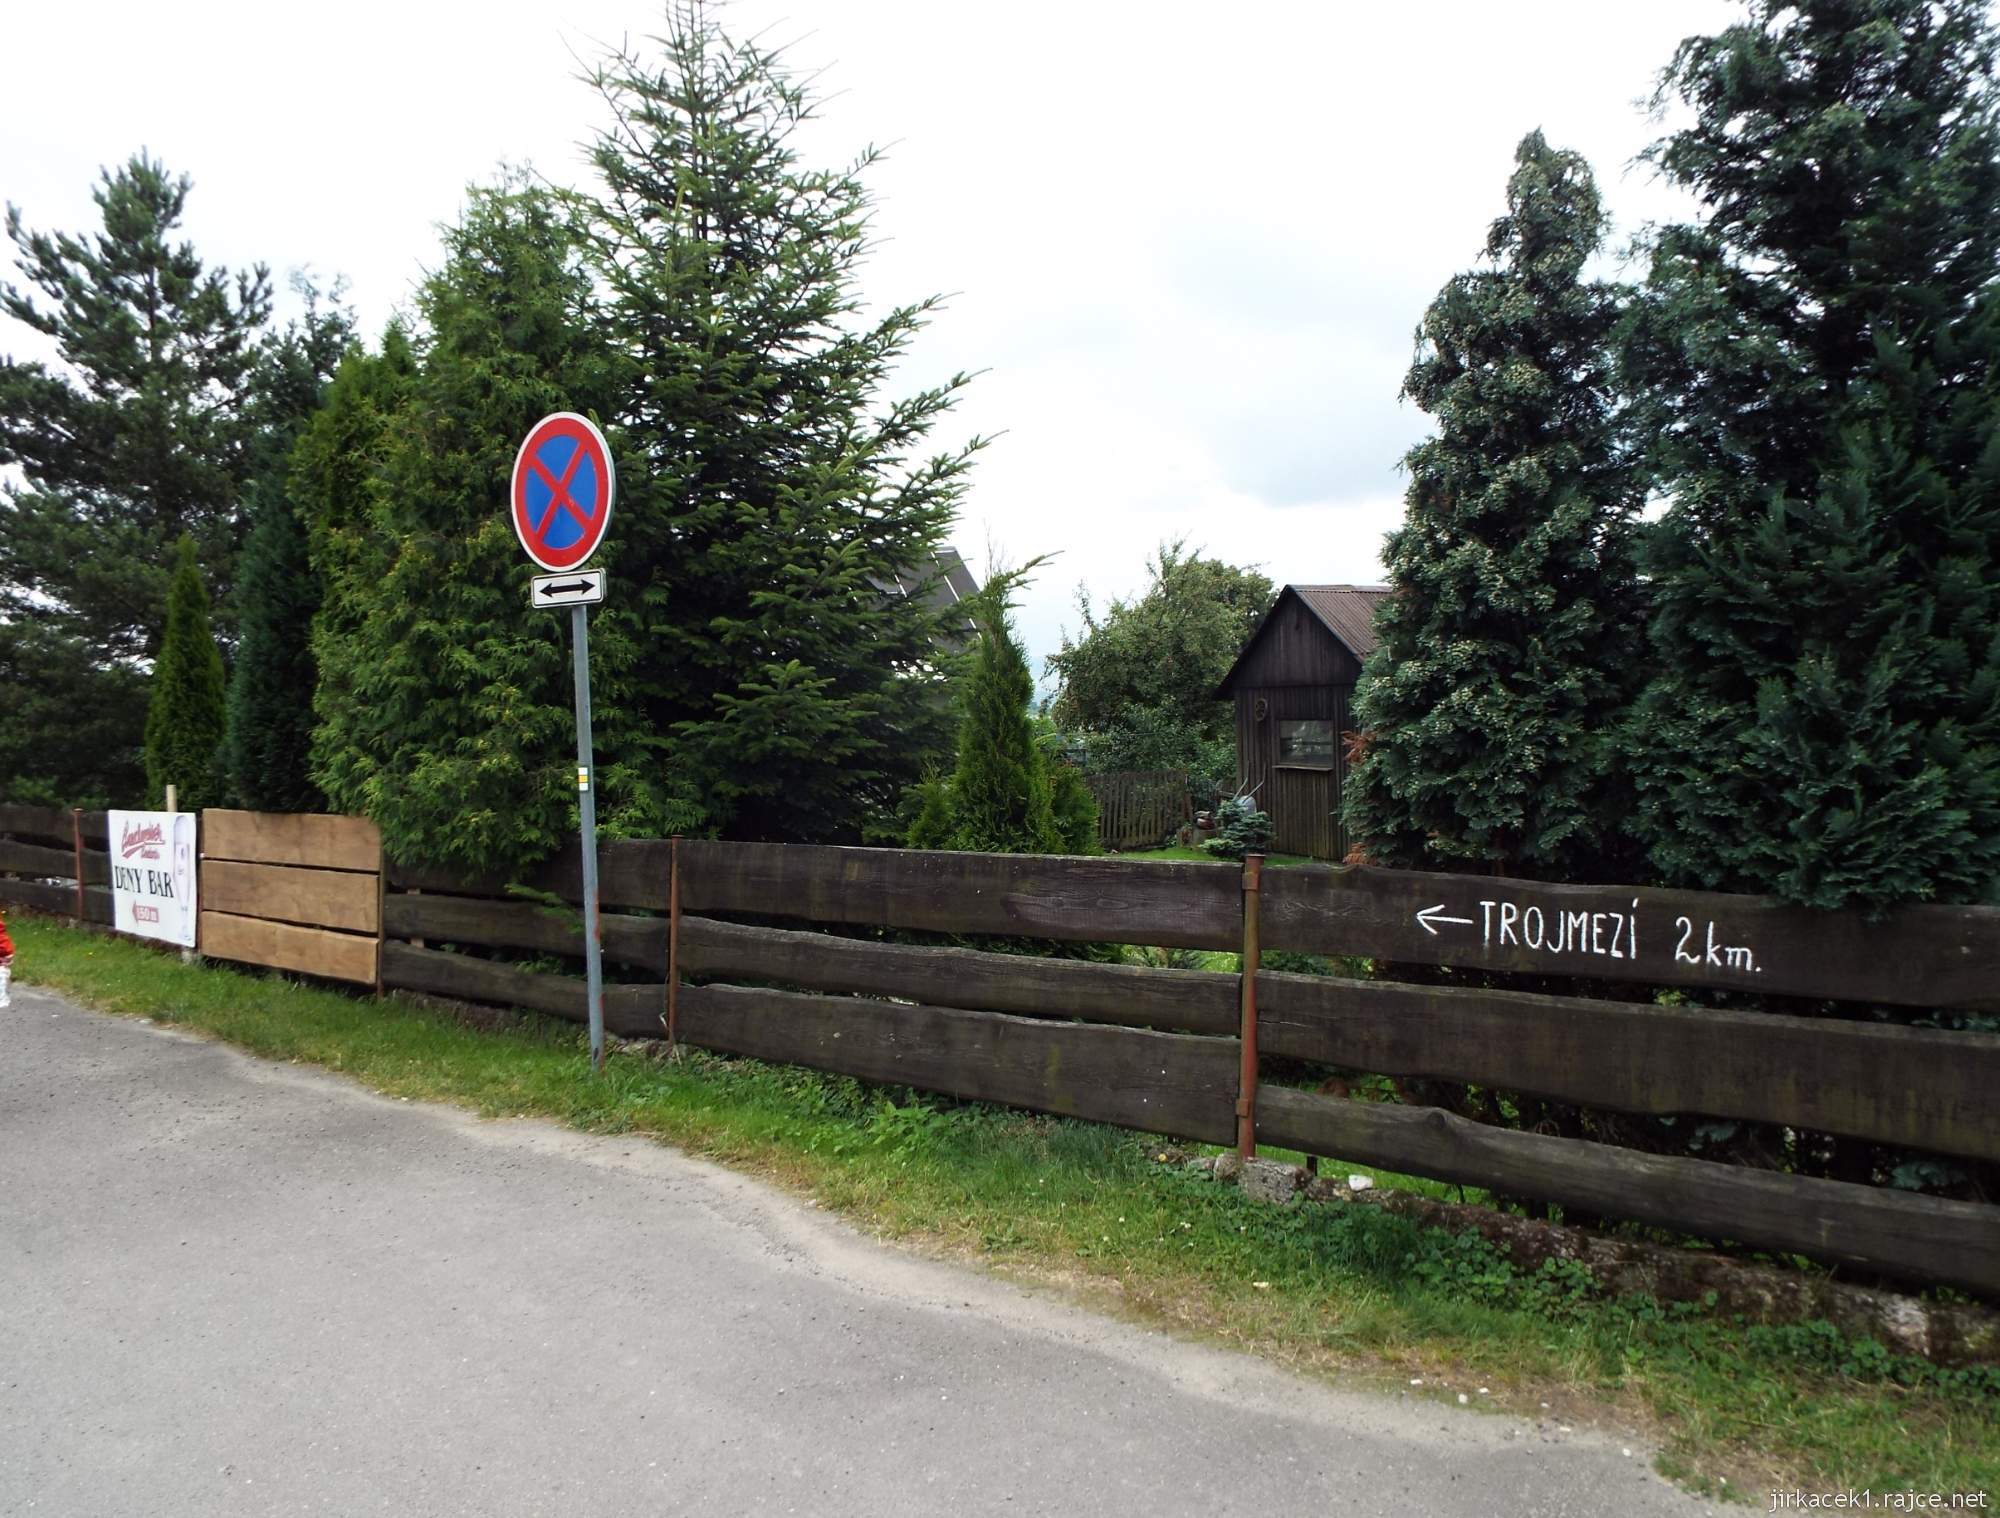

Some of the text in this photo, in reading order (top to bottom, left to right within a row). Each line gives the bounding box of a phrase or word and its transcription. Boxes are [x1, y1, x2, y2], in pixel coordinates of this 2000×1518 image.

[115, 865, 174, 898] DENY BAR
[1479, 898, 1638, 959] TROJMEZÍ
